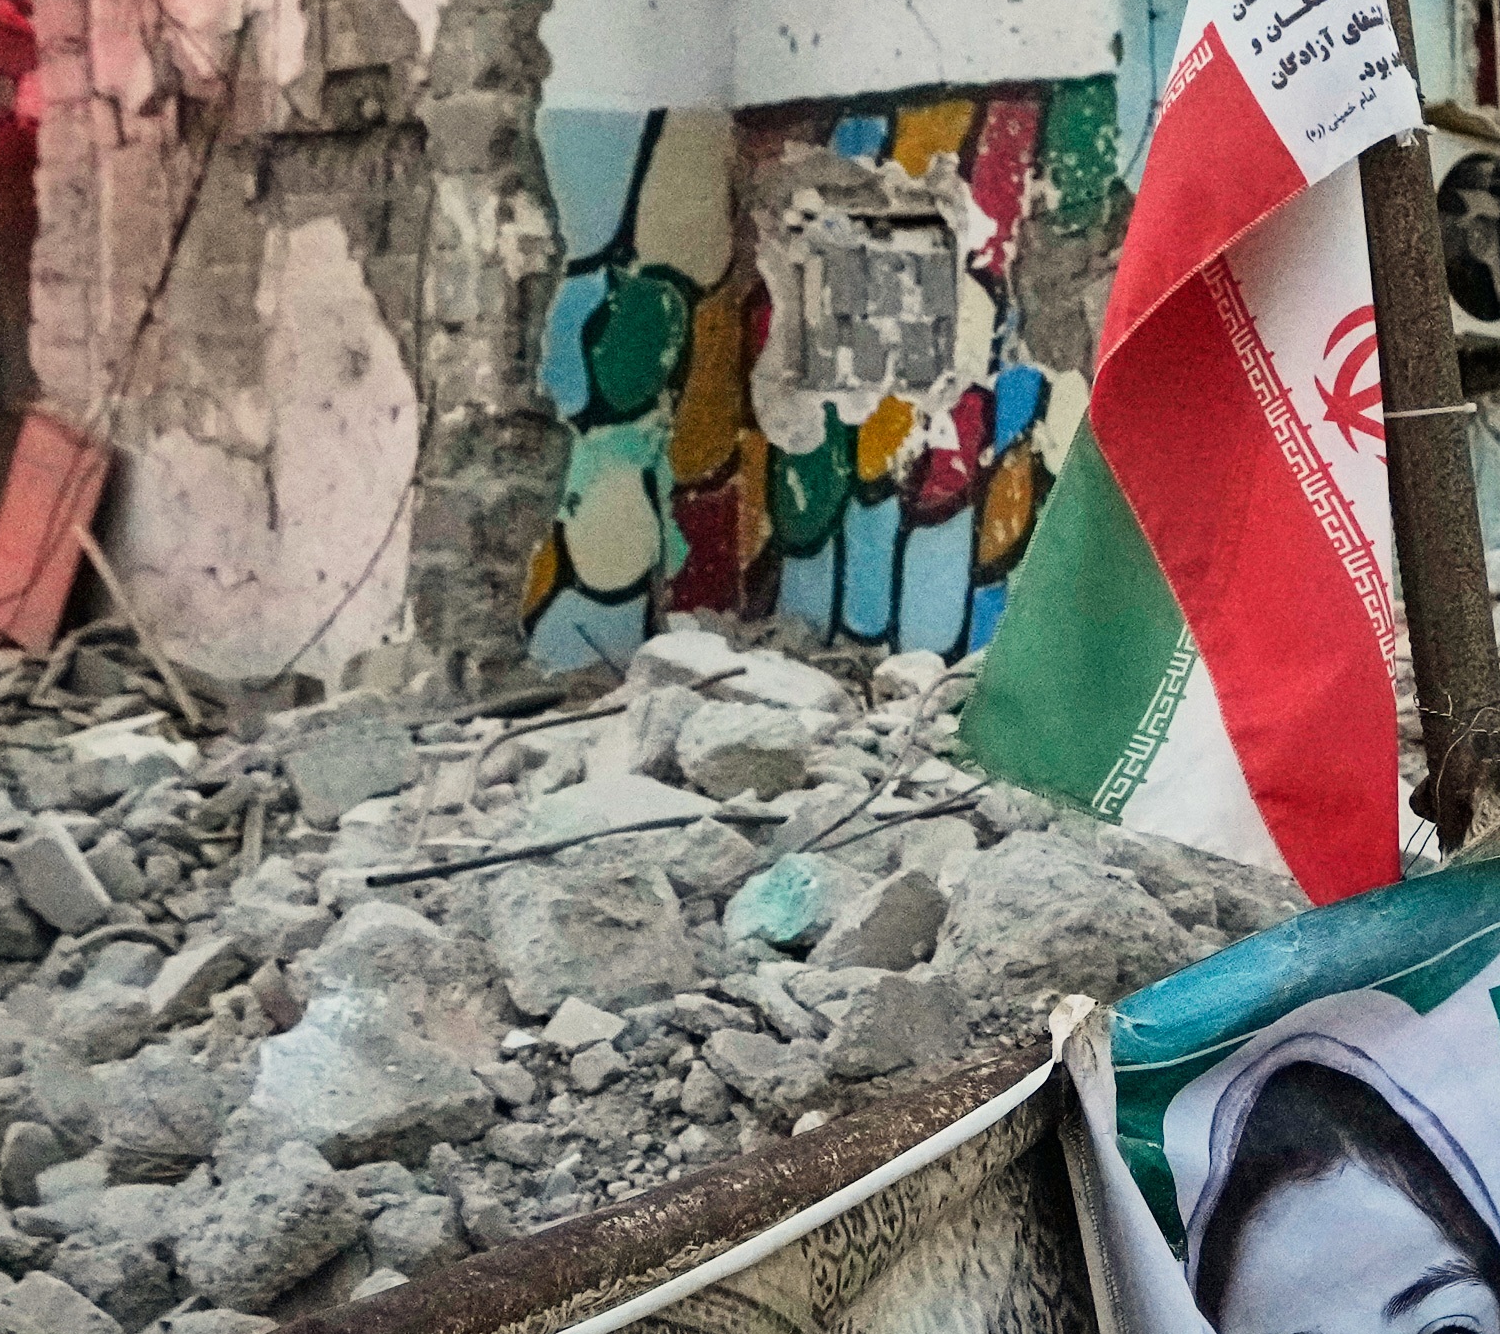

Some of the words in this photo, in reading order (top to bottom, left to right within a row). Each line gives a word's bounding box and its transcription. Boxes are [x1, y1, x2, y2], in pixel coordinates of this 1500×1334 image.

[1251, 37, 1263, 56] و
[1271, 26, 1334, 91] آزادگان
[1360, 86, 1377, 110] امام
[1328, 102, 1356, 133] خمینی
[1306, 123, 1326, 143] (ره)
